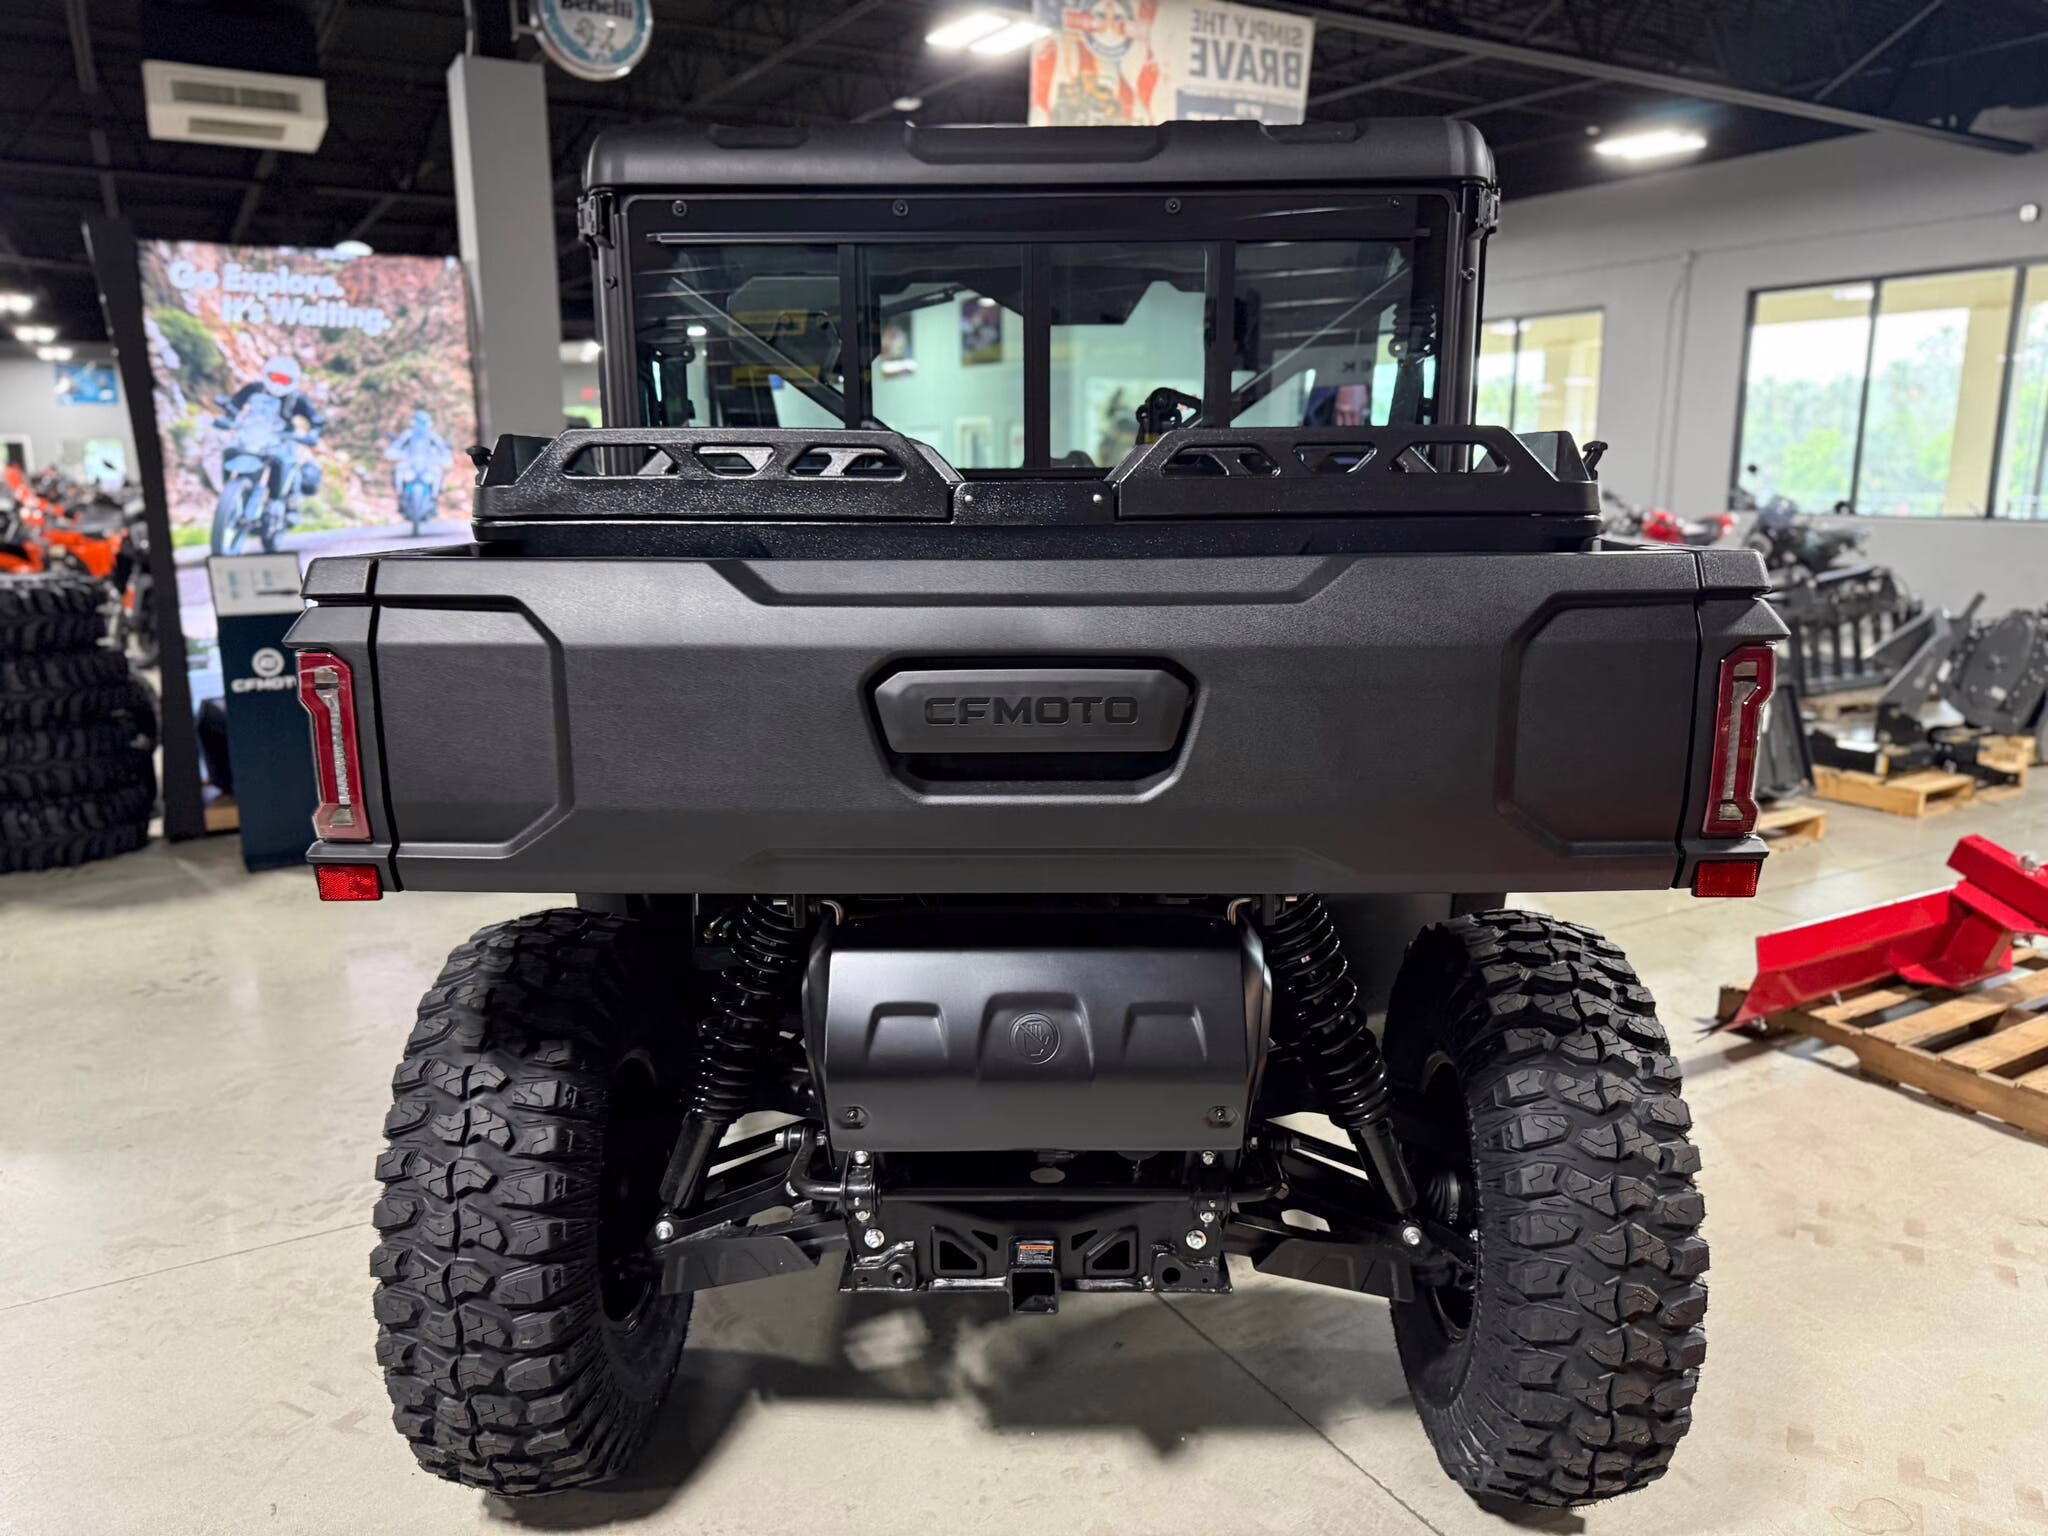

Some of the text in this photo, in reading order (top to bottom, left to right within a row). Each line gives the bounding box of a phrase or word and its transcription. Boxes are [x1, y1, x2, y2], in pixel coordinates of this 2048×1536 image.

[168, 260, 344, 298] Go Explore.
[268, 297, 391, 336] Waiting.
[231, 676, 297, 693] CFMOT
[924, 696, 1139, 725] CFMOTO
